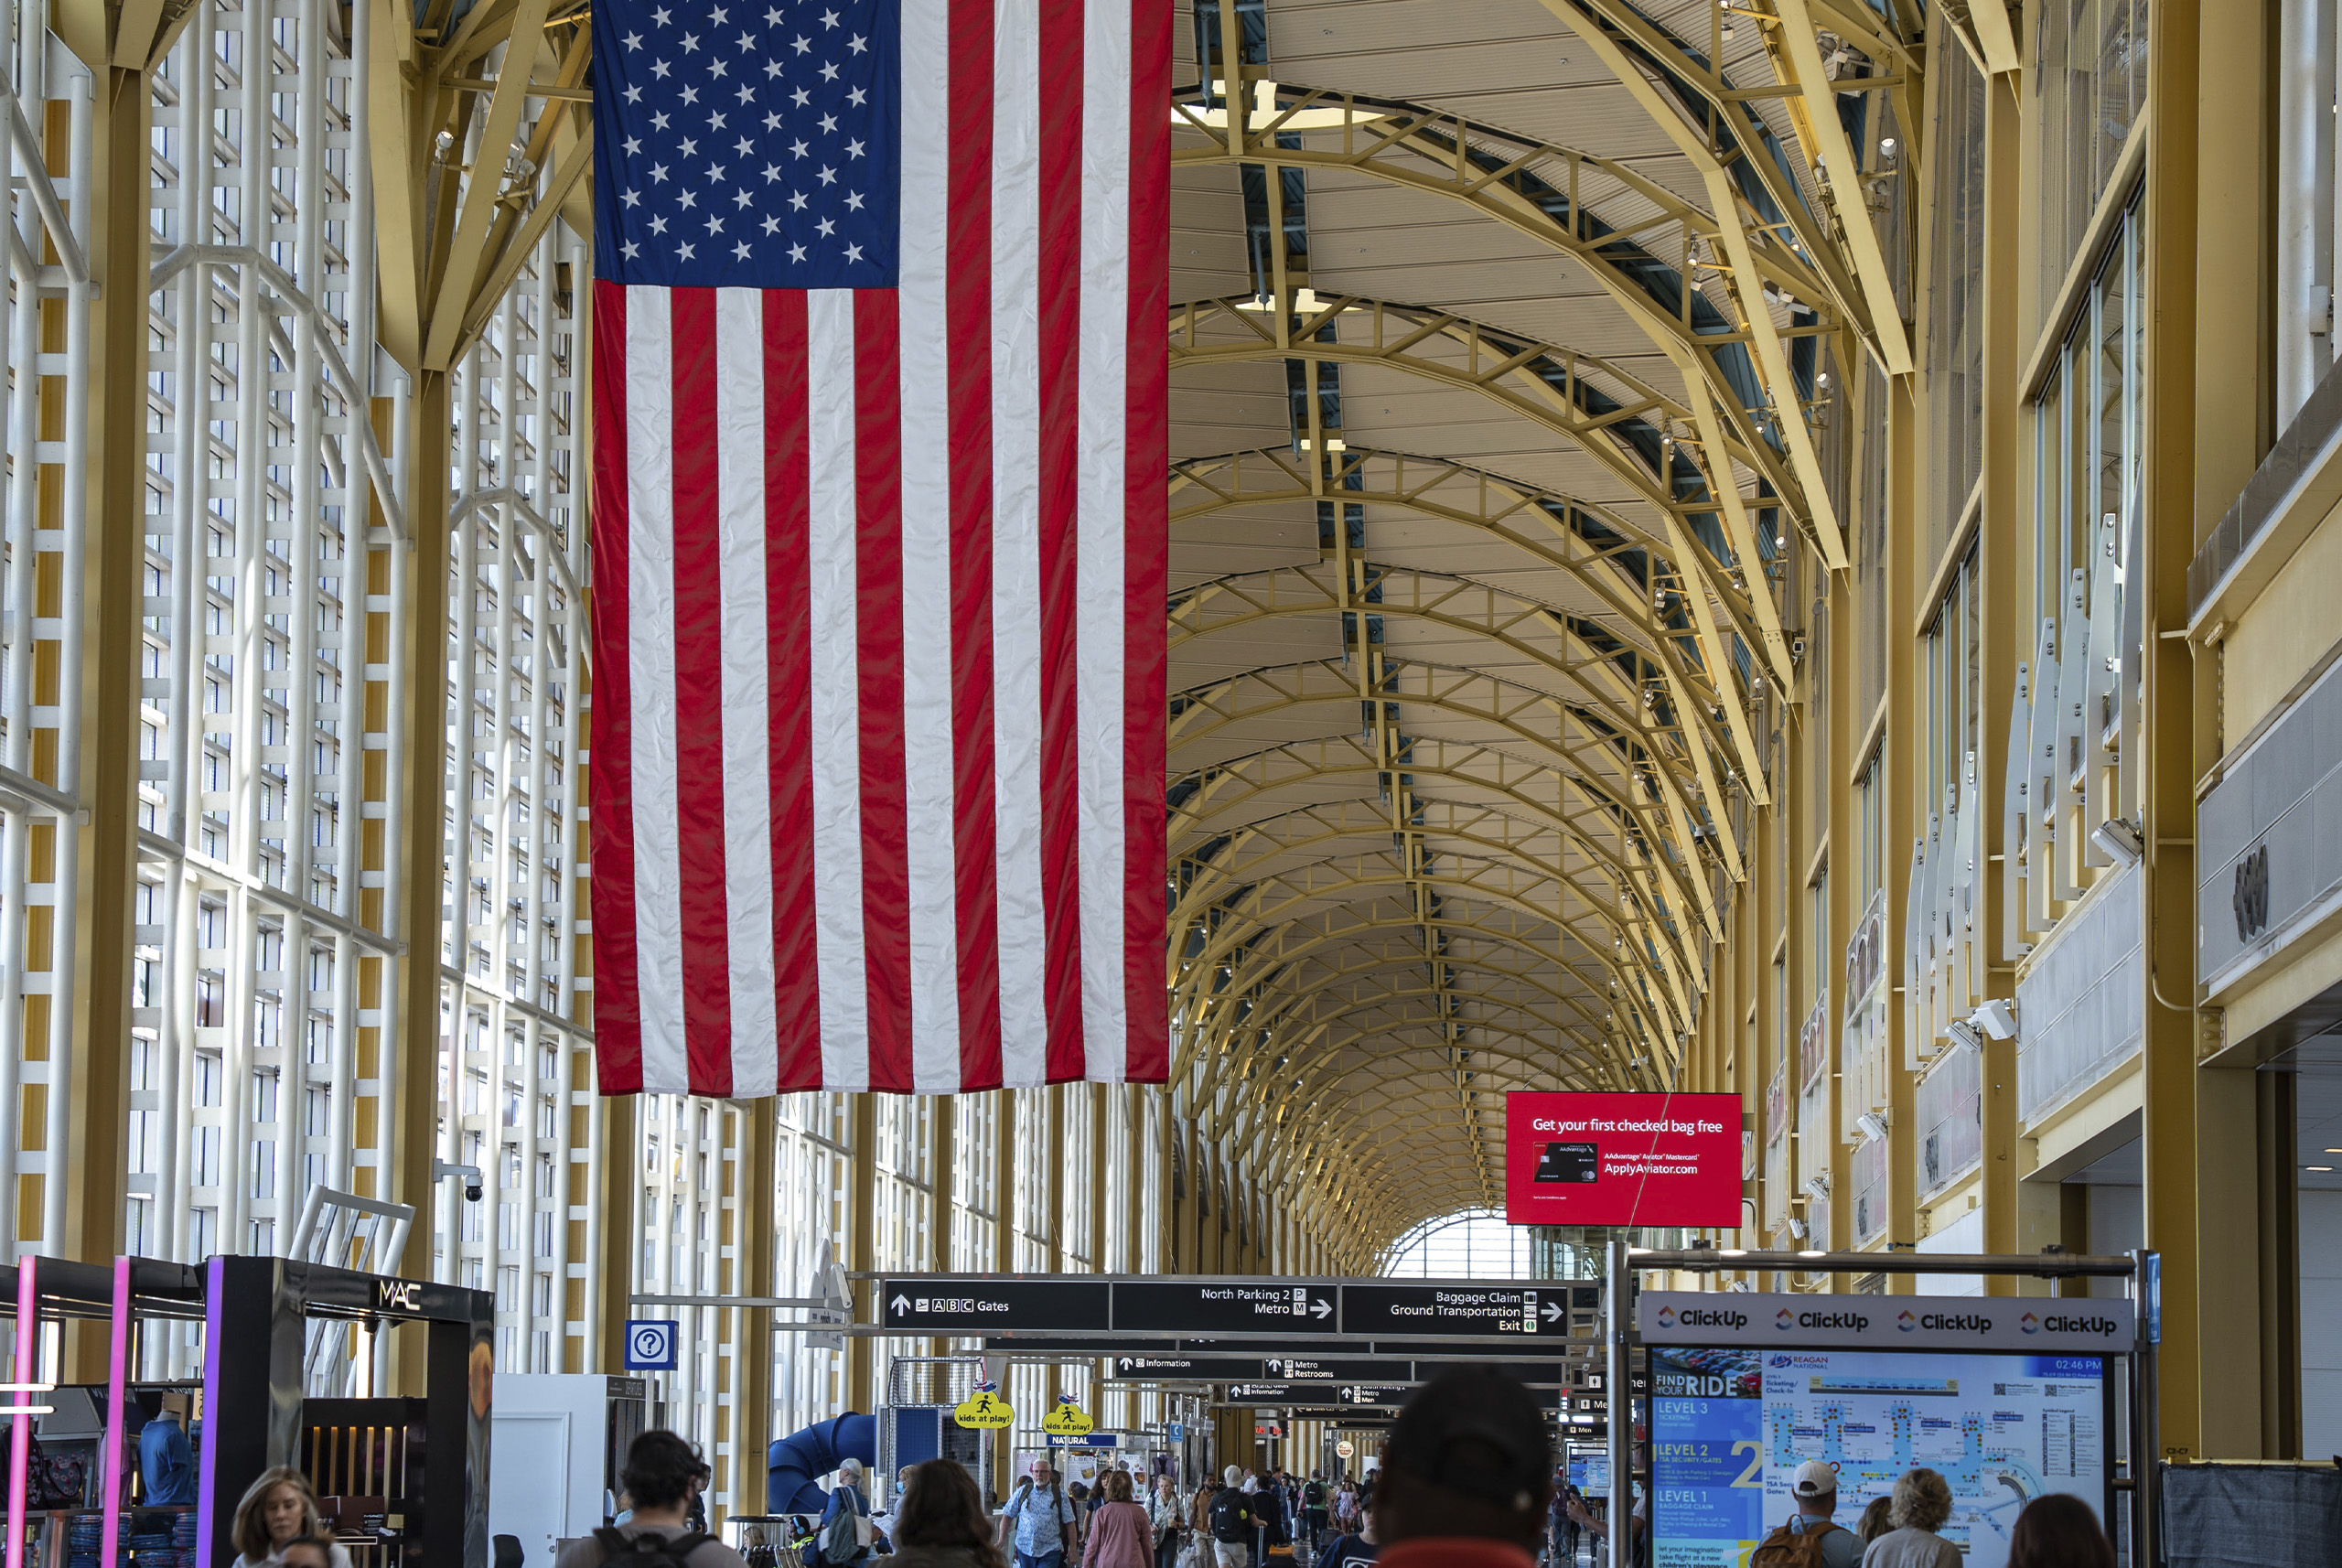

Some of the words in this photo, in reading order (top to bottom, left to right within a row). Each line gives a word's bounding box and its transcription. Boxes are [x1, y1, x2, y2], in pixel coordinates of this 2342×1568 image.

[1532, 1119, 1555, 1131] Get
[1558, 1121, 1587, 1134] your
[1590, 1119, 1615, 1132] first
[1617, 1120, 1668, 1133] checked
[1671, 1121, 1695, 1135] bag
[1698, 1121, 1723, 1133] free
[1605, 1163, 1698, 1176] ApplyAviator.com
[1201, 1289, 1233, 1299] North
[1237, 1289, 1280, 1302] Parking
[1283, 1290, 1290, 1300] 2
[1436, 1292, 1486, 1305] Baggage
[1488, 1292, 1520, 1303] Claim
[977, 1301, 1009, 1312] Gates
[1254, 1304, 1290, 1314] Metro
[1391, 1305, 1434, 1316] Ground
[1436, 1305, 1520, 1318] Transportation
[1680, 1309, 1748, 1330] ClickUp
[1799, 1311, 1869, 1332] ClickUp
[1920, 1314, 1993, 1335] ClickUp
[1499, 1320, 1520, 1331] Exit
[2044, 1316, 2117, 1337] ClickUp
[1146, 1359, 1190, 1368] Information
[1793, 1356, 1829, 1364] REAGAN
[2056, 1359, 2083, 1369] 02:46
[2086, 1361, 2102, 1369] PM
[1656, 1375, 1685, 1386] FIND
[1766, 1380, 1799, 1388] Ticketing/
[1656, 1386, 1683, 1395] YOUR
[1686, 1376, 1738, 1397] RIDE
[1659, 1402, 1696, 1414] LEVEL
[1700, 1402, 1708, 1414] 3
[989, 1415, 1010, 1424] play!
[1072, 1423, 1090, 1432] play!
[1659, 1444, 1696, 1456] LEVEL
[1700, 1444, 1709, 1456] 2
[1659, 1490, 1696, 1502] LEVEL
[1702, 1491, 1707, 1502] 1
[1684, 1546, 1724, 1554] imagination
[1674, 1554, 1692, 1563] flight
